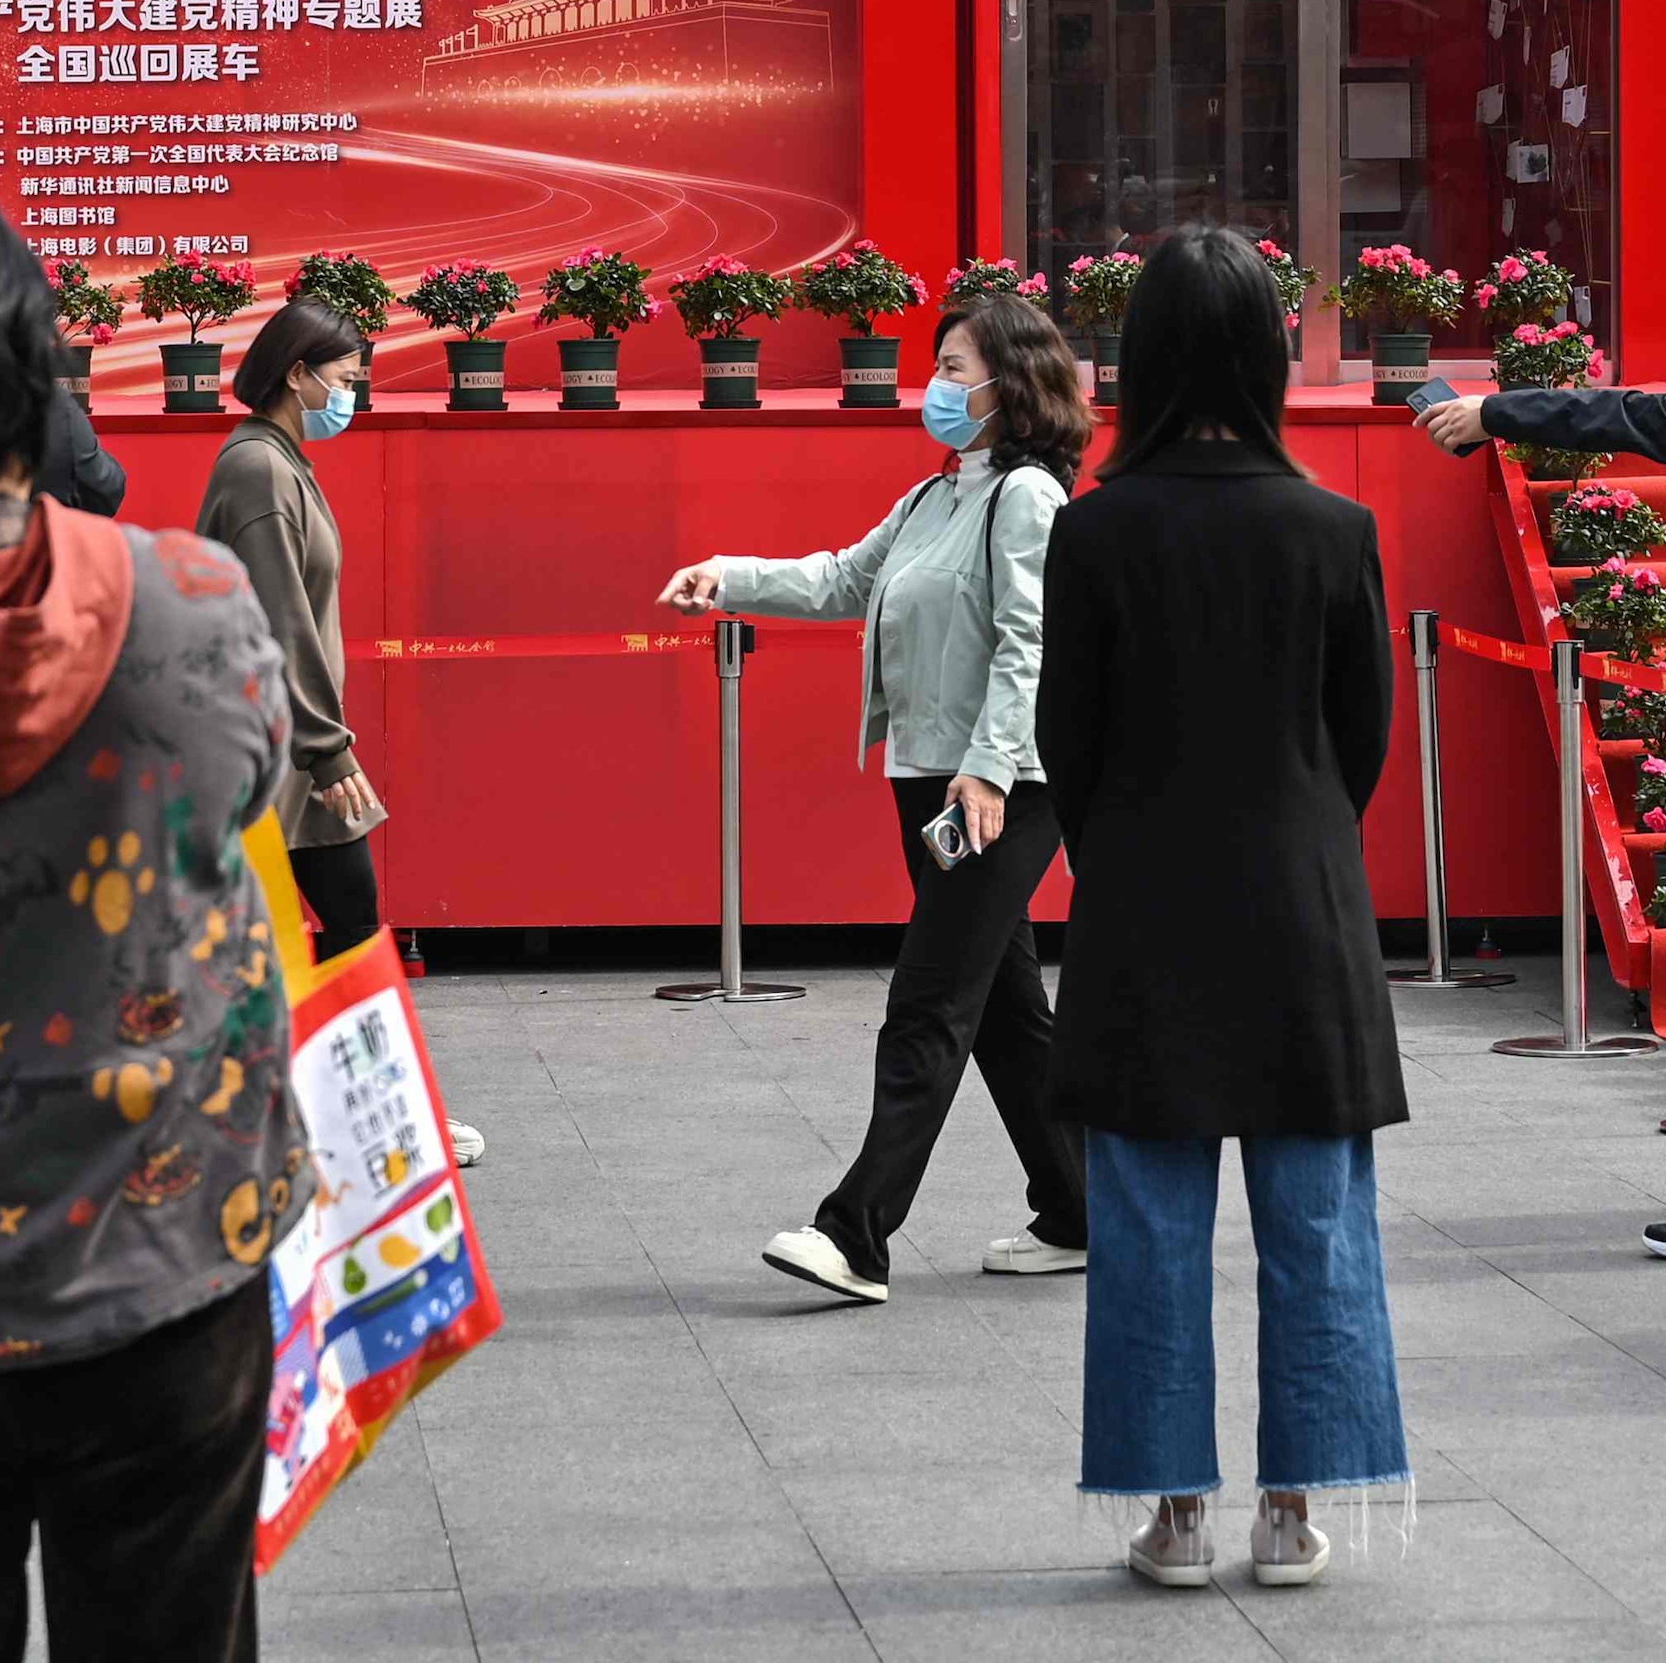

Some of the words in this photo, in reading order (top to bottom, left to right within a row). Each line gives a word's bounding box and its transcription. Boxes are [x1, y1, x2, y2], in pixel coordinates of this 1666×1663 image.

[17, 41, 260, 84] 全国巡回展车
[20, 175, 230, 196] 新华通讯社新闻信息中心
[20, 207, 116, 226] 上海图书馆
